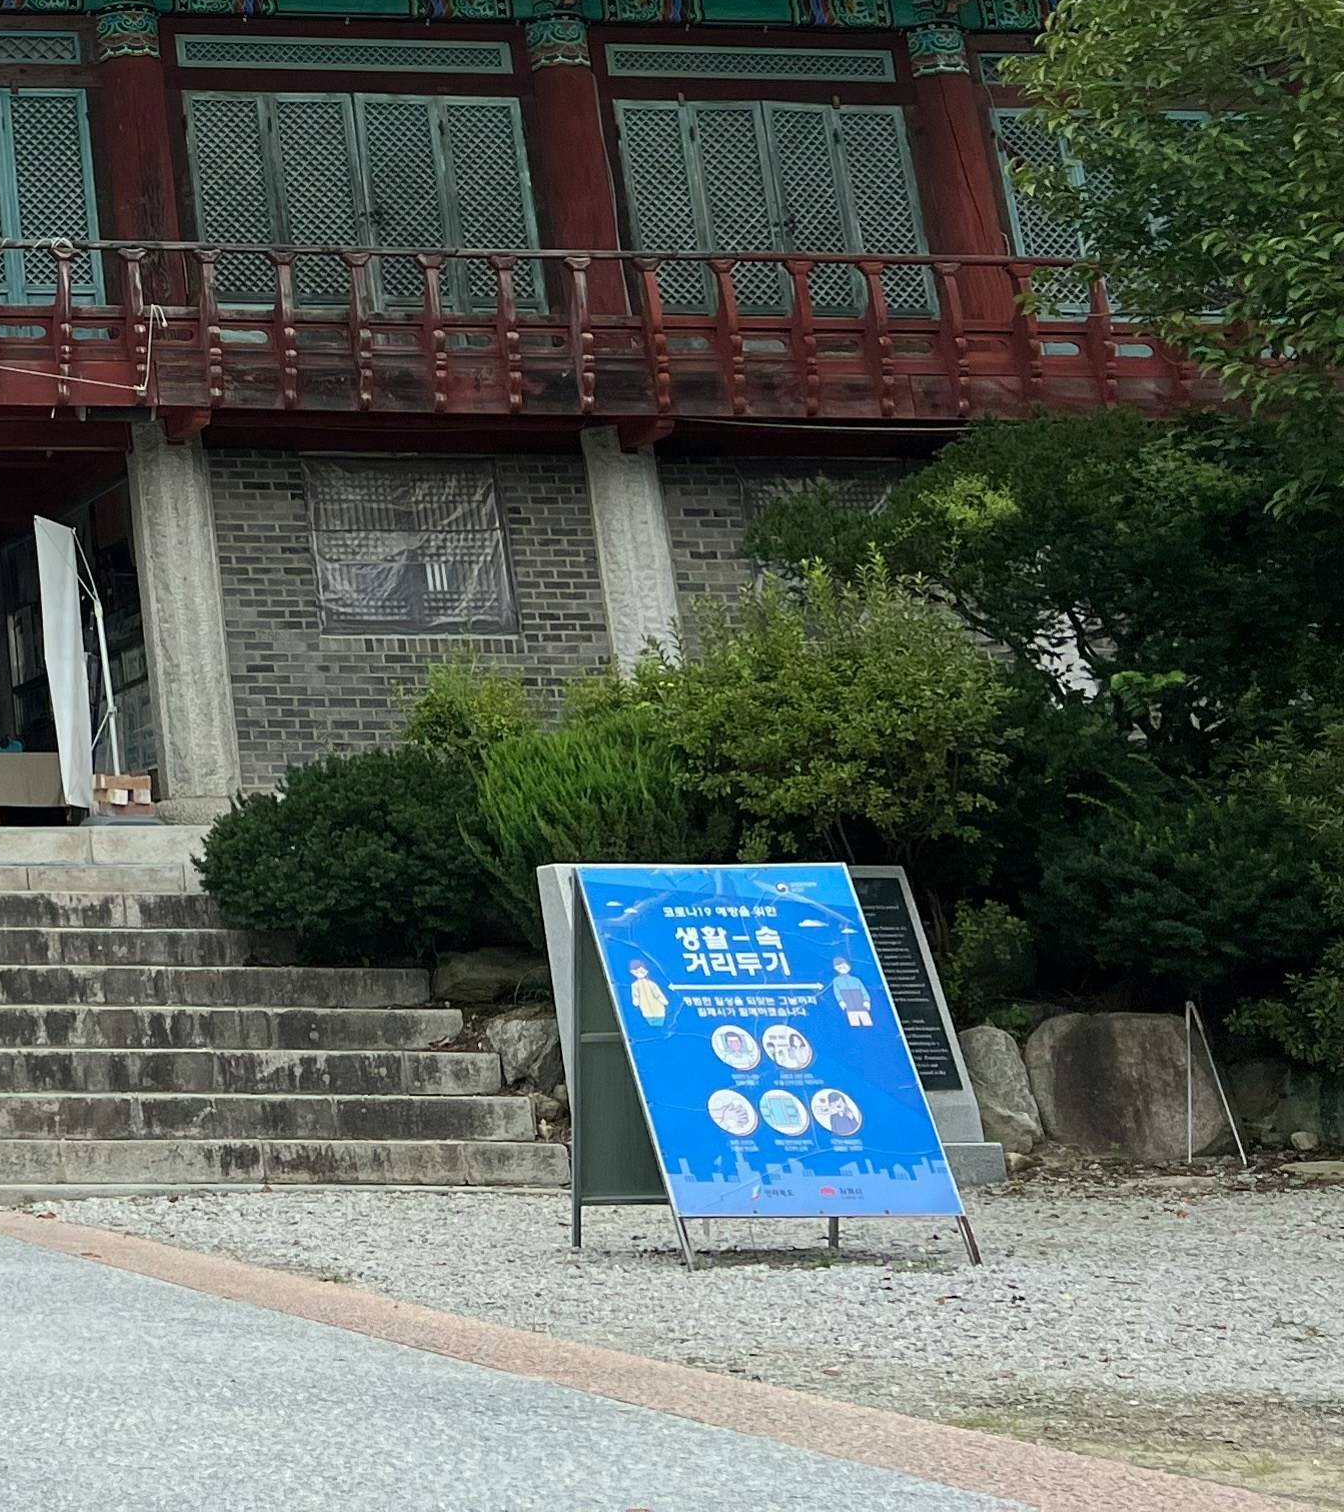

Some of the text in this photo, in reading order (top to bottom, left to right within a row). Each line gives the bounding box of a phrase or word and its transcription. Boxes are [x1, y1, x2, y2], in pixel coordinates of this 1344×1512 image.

[663, 906, 777, 918] 코로나19 예방을 위한
[675, 925, 729, 951] 생활
[755, 925, 783, 950] 속
[682, 952, 791, 977] 거리두기
